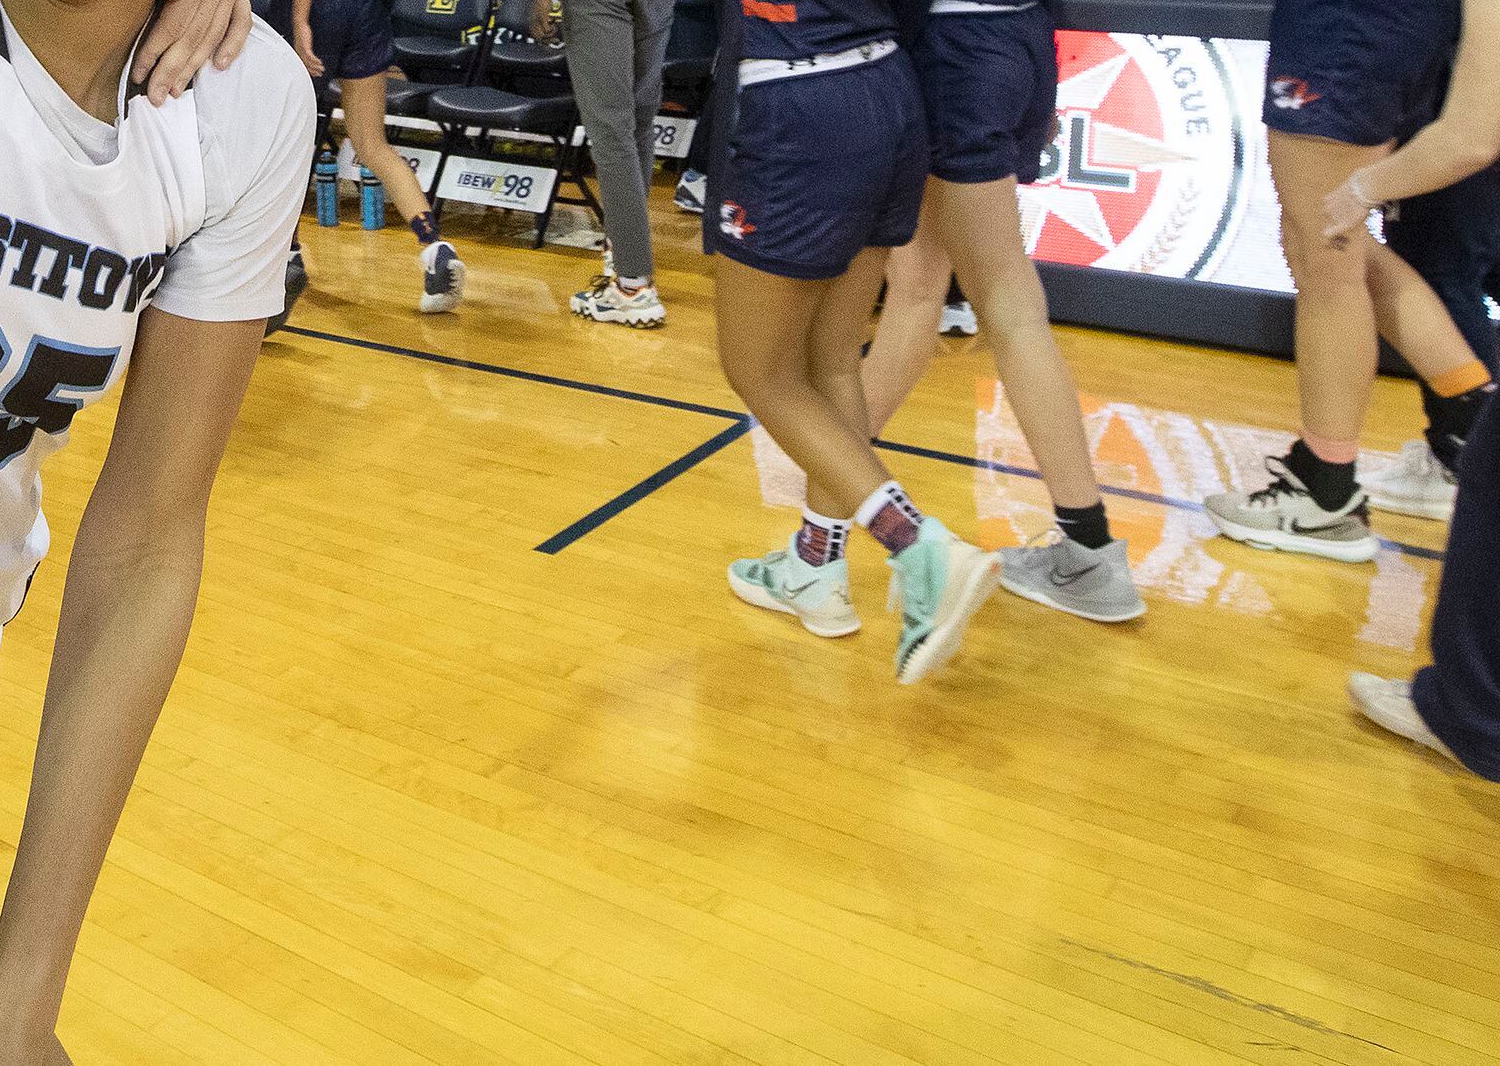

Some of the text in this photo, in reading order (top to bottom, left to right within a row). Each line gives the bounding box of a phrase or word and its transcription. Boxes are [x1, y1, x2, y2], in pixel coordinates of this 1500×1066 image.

[1145, 35, 1211, 136] AGUE
[457, 171, 534, 199] IBEW 98
